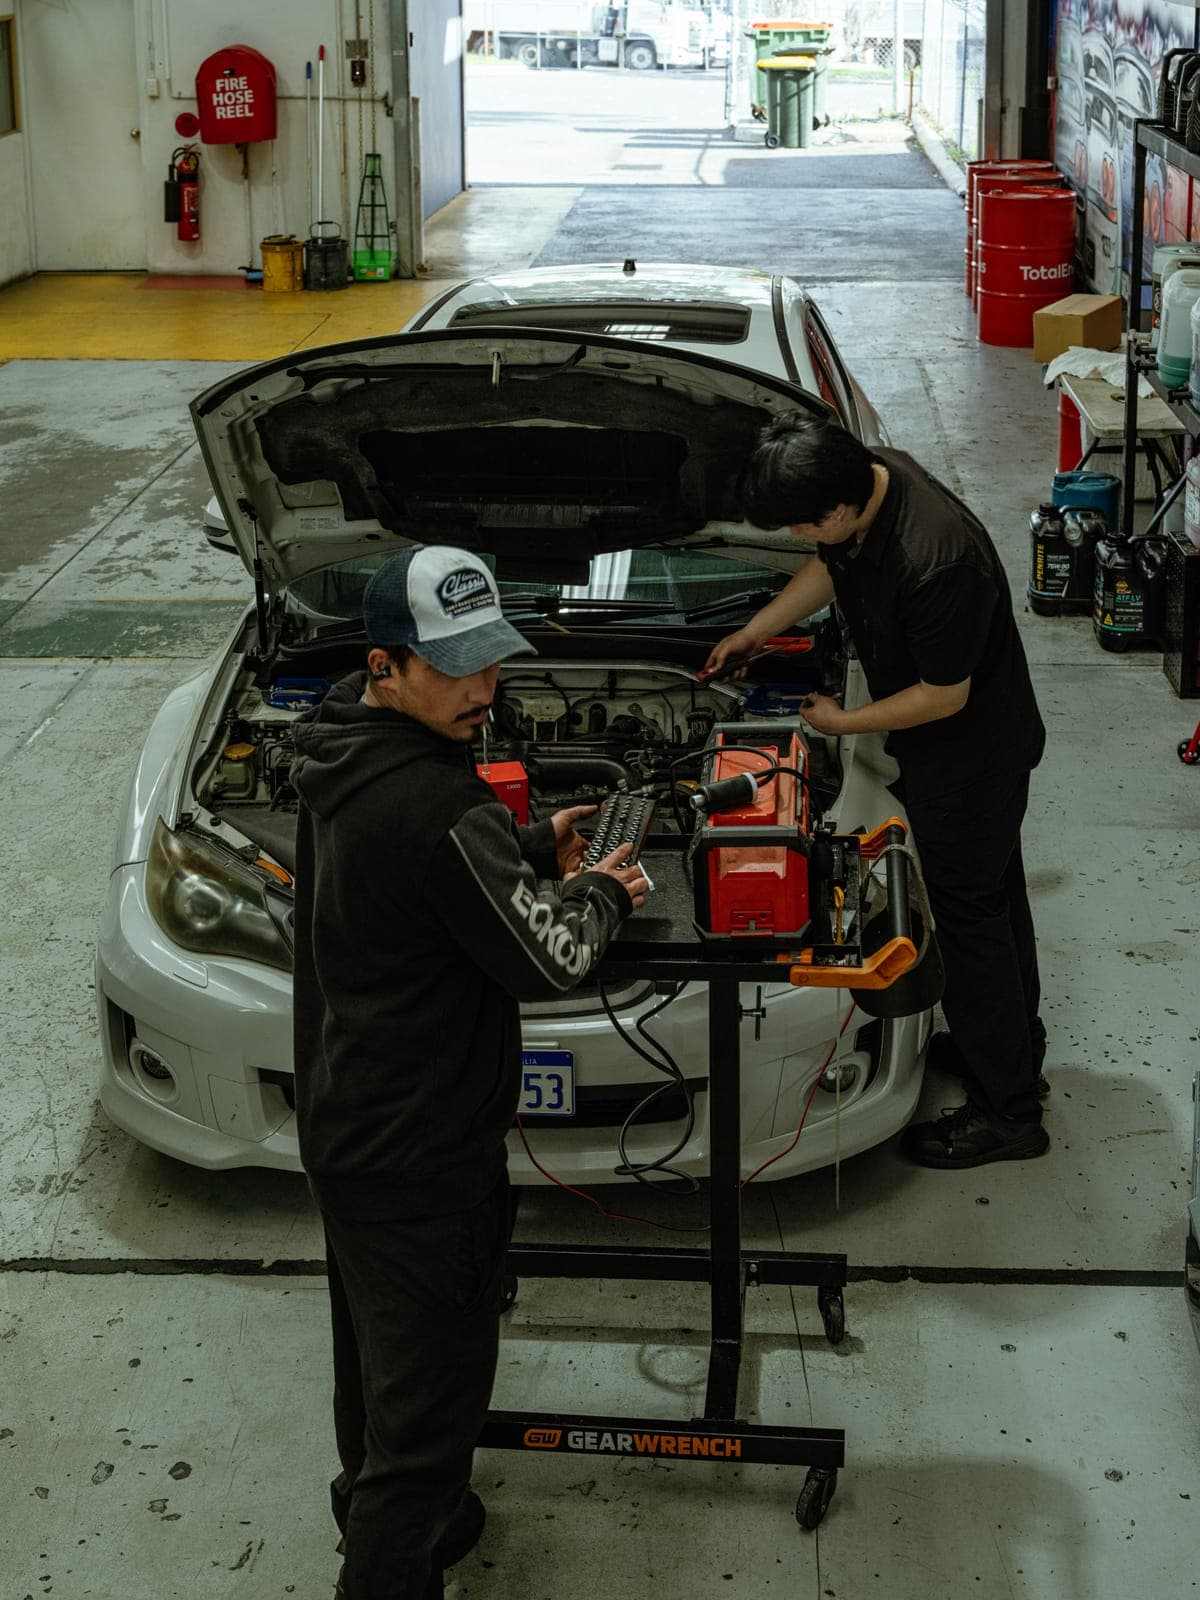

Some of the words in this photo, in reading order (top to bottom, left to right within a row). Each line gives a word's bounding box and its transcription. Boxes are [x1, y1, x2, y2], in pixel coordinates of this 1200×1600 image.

[215, 76, 249, 92] FIRE
[211, 89, 255, 106] HOSE
[215, 104, 255, 120] REEL
[1036, 543, 1045, 581] PENRITE
[567, 1430, 742, 1457] GEARWRENCH
